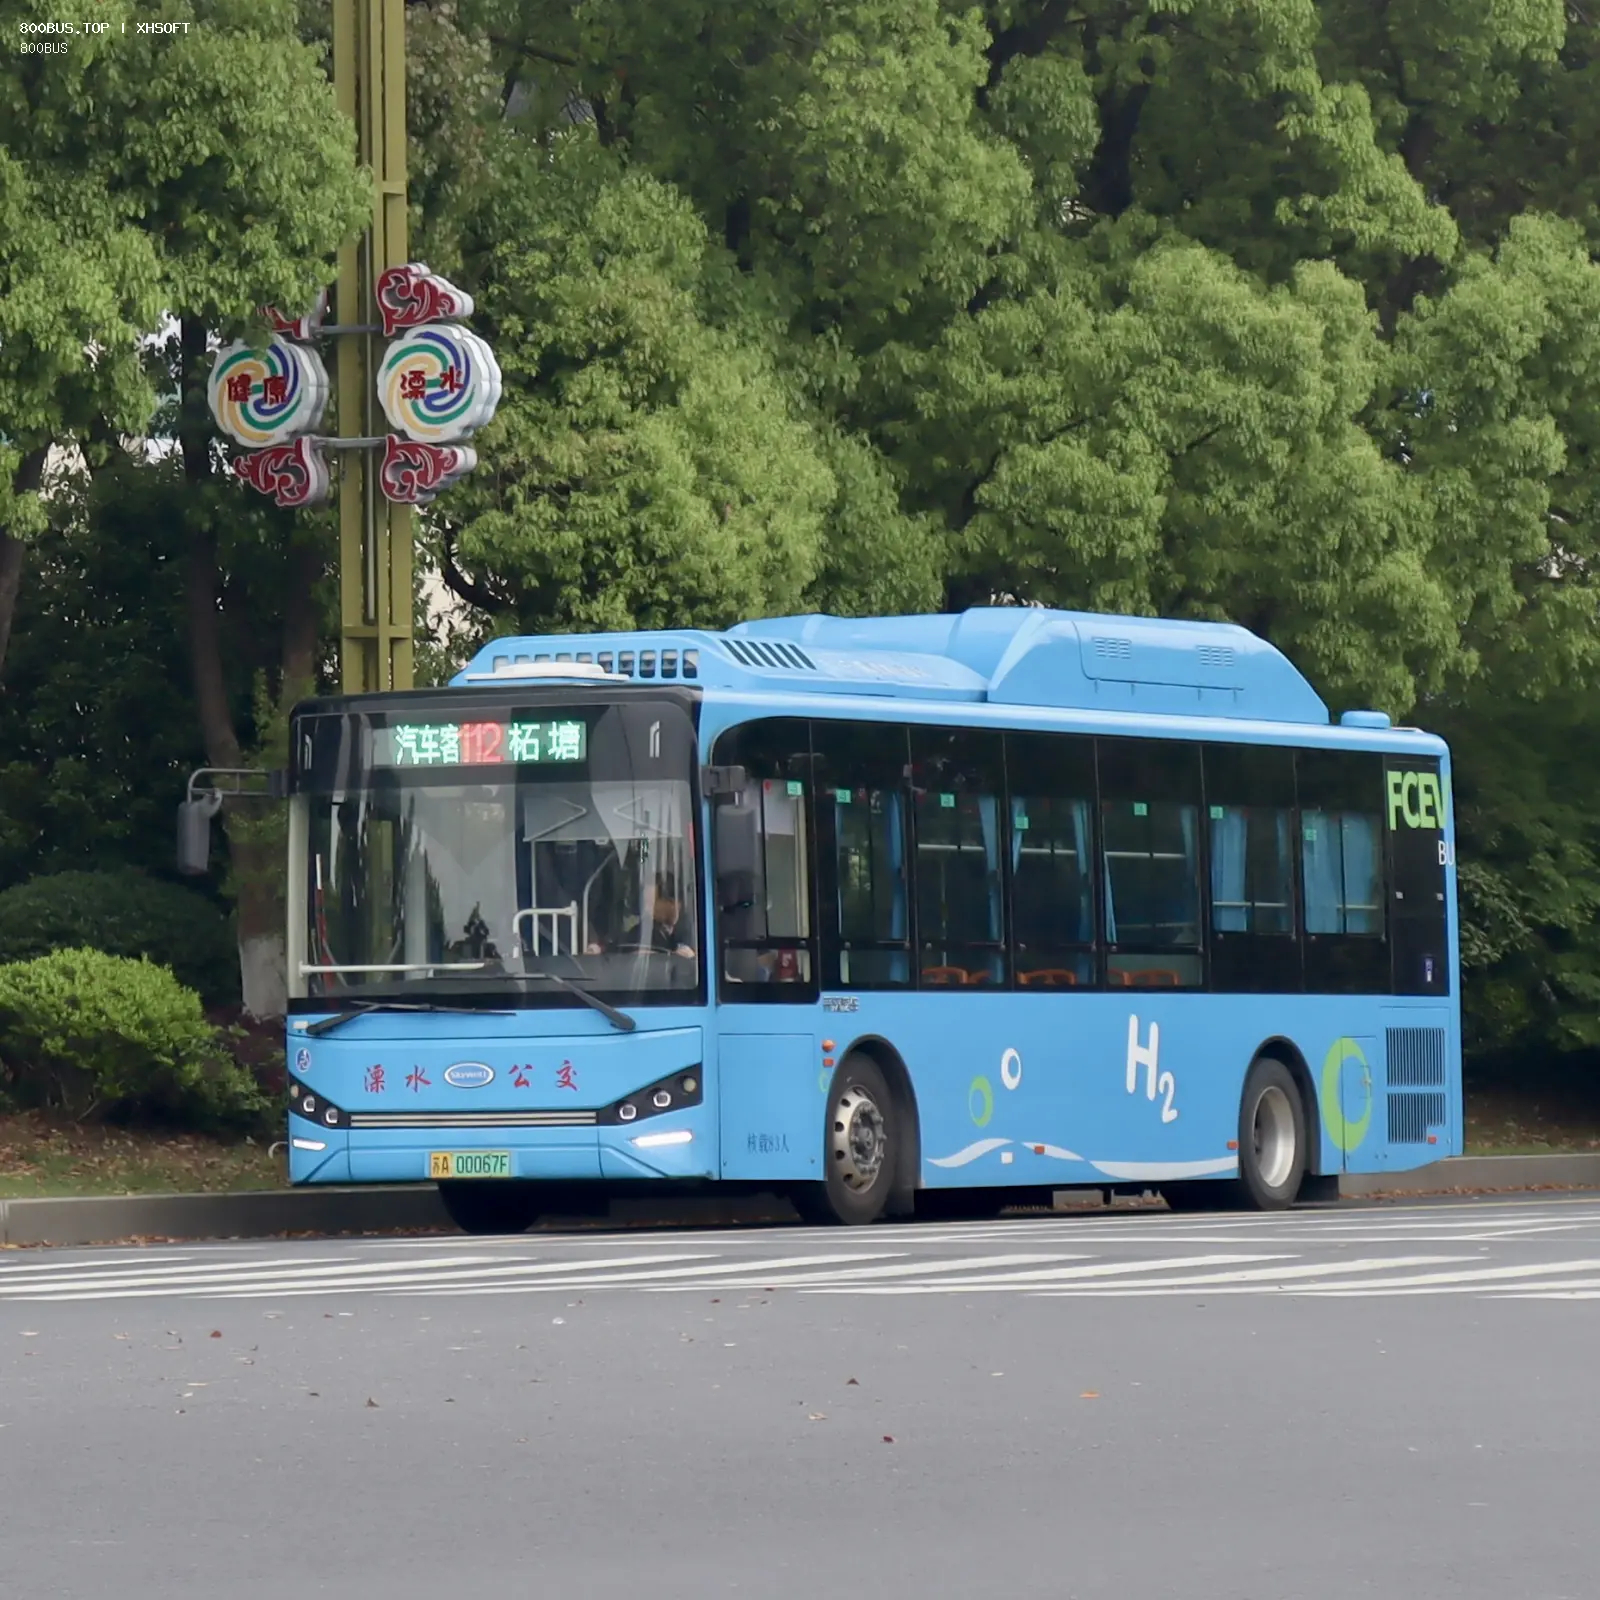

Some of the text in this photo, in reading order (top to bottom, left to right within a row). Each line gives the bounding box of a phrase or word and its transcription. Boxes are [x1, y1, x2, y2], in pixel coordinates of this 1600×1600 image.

[400, 365, 465, 399] 溧水
[395, 723, 459, 765] 汽车客
[507, 720, 581, 762] 柘塘
[1387, 769, 1451, 831] FCEV
[363, 1059, 579, 1095] 溧水 公交
[456, 1154, 509, 1175] 00067F
